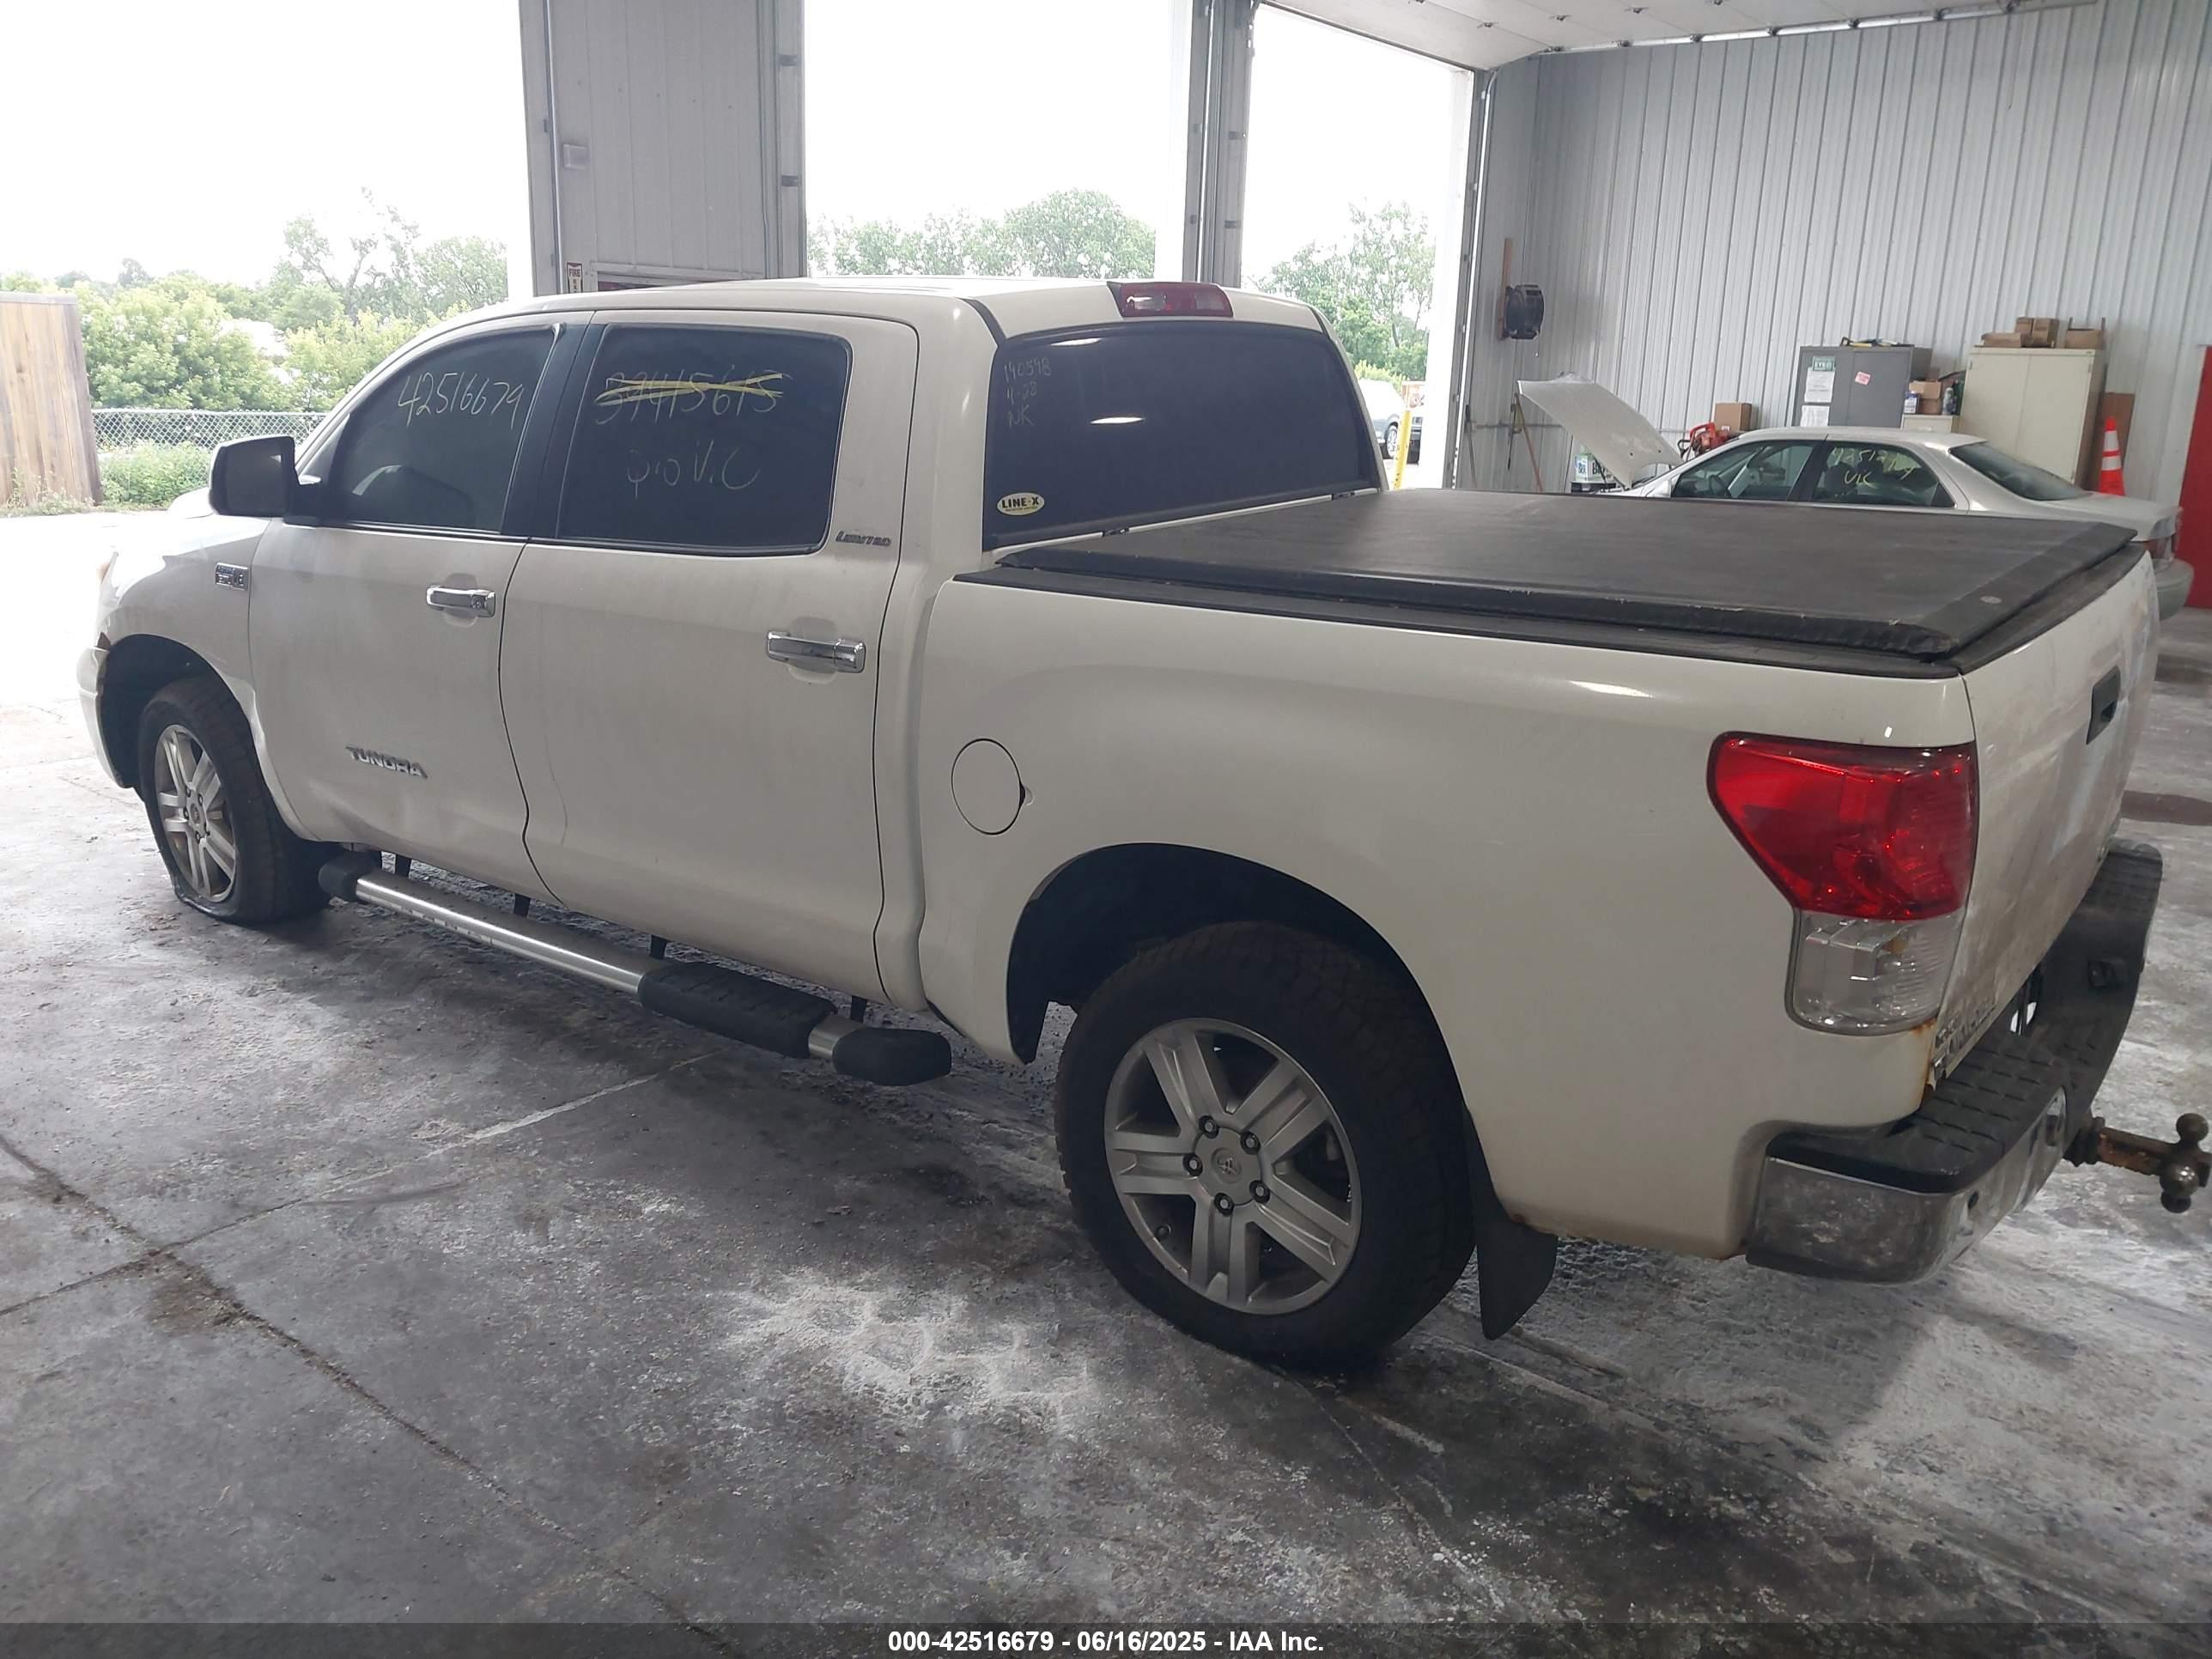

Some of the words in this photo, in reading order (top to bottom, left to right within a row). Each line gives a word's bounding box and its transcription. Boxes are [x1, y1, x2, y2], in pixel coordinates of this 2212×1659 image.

[398, 371, 526, 430] 42516679
[1001, 495, 1040, 509] LINE-X
[345, 744, 428, 779] TUNDRA
